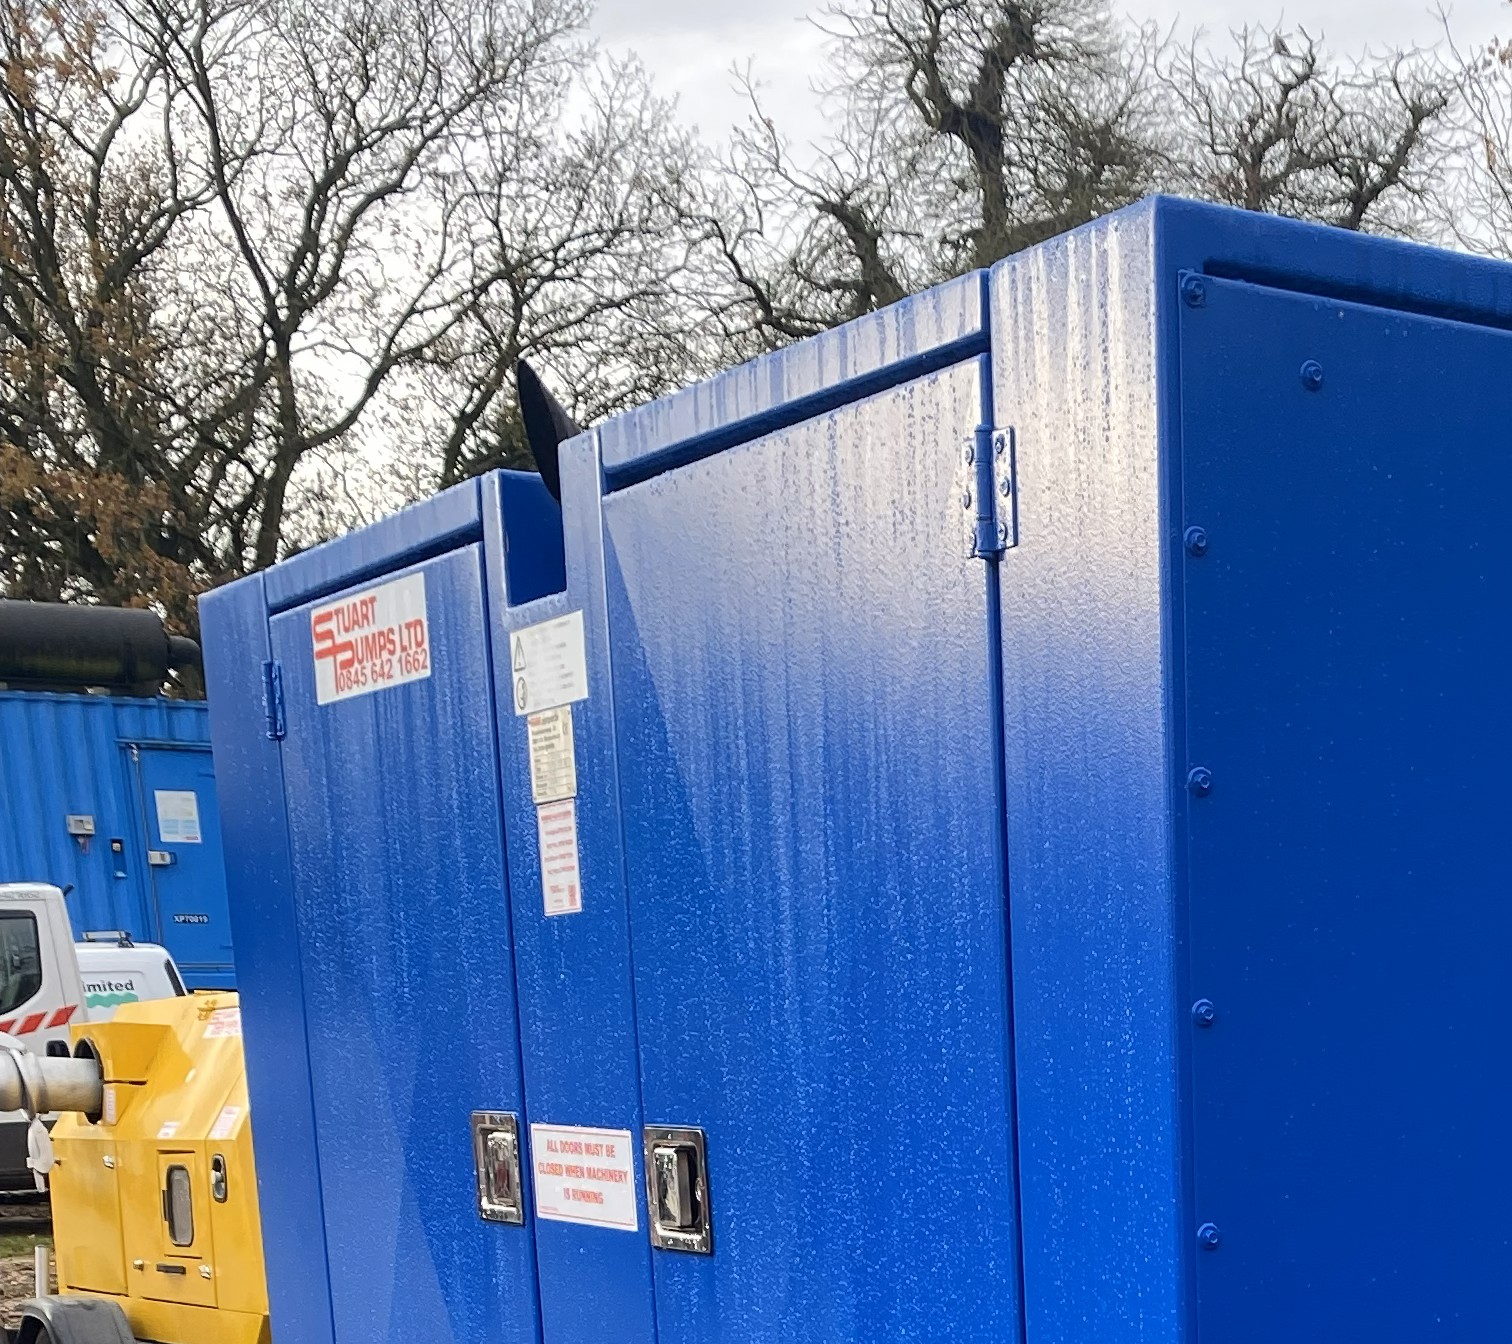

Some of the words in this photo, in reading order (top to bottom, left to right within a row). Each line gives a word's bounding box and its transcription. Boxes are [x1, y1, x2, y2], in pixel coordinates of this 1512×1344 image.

[313, 595, 377, 643] STUART
[315, 627, 396, 694] PUMPS
[398, 618, 425, 654] LTD
[338, 666, 367, 692] 0845
[370, 658, 394, 684] 642
[398, 648, 428, 676] 1662
[82, 979, 135, 993] imited
[546, 1138, 559, 1153] ALL
[560, 1140, 583, 1155] DOORS
[584, 1142, 604, 1157] MUST
[606, 1144, 616, 1158] BE
[538, 1162, 563, 1177] CLOSED
[564, 1164, 585, 1179] WHEN
[586, 1167, 628, 1185] MACHINERY
[563, 1187, 571, 1201] IS
[572, 1188, 604, 1205] RUNNING
